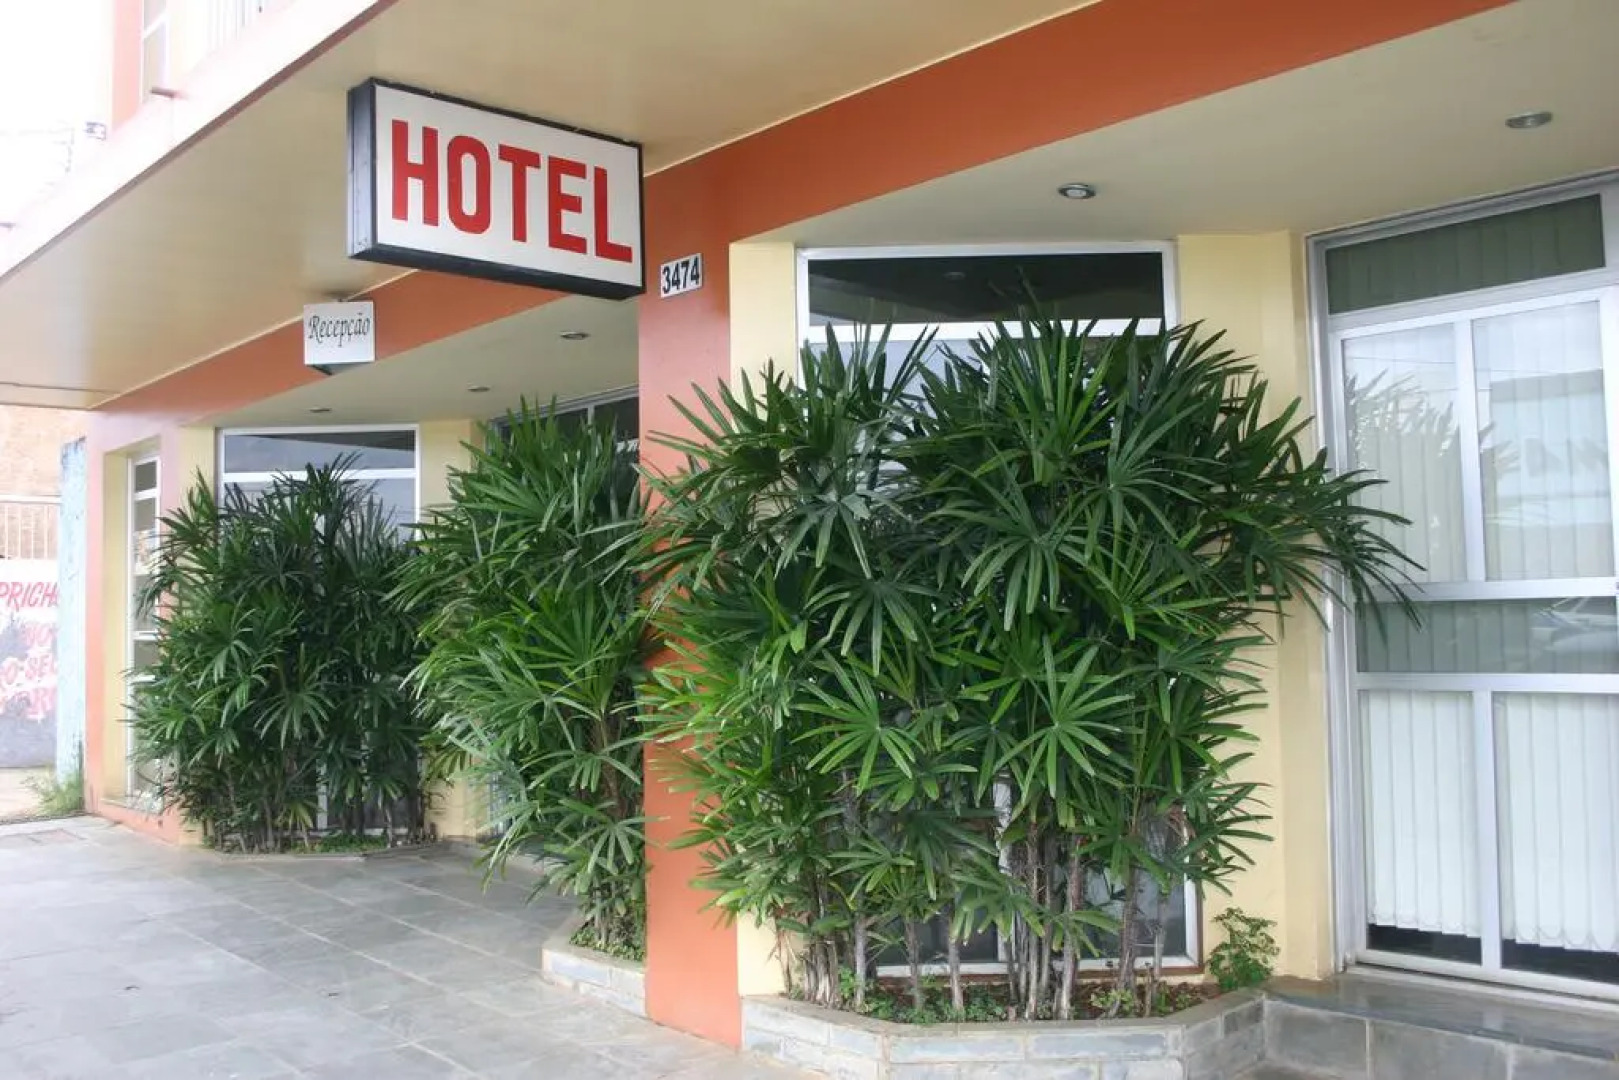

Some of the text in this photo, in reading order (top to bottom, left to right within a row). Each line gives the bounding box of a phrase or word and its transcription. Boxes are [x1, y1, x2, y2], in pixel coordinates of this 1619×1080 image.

[391, 119, 633, 263] HOTEL
[662, 255, 700, 295] 3474
[308, 312, 371, 348] Recepção
